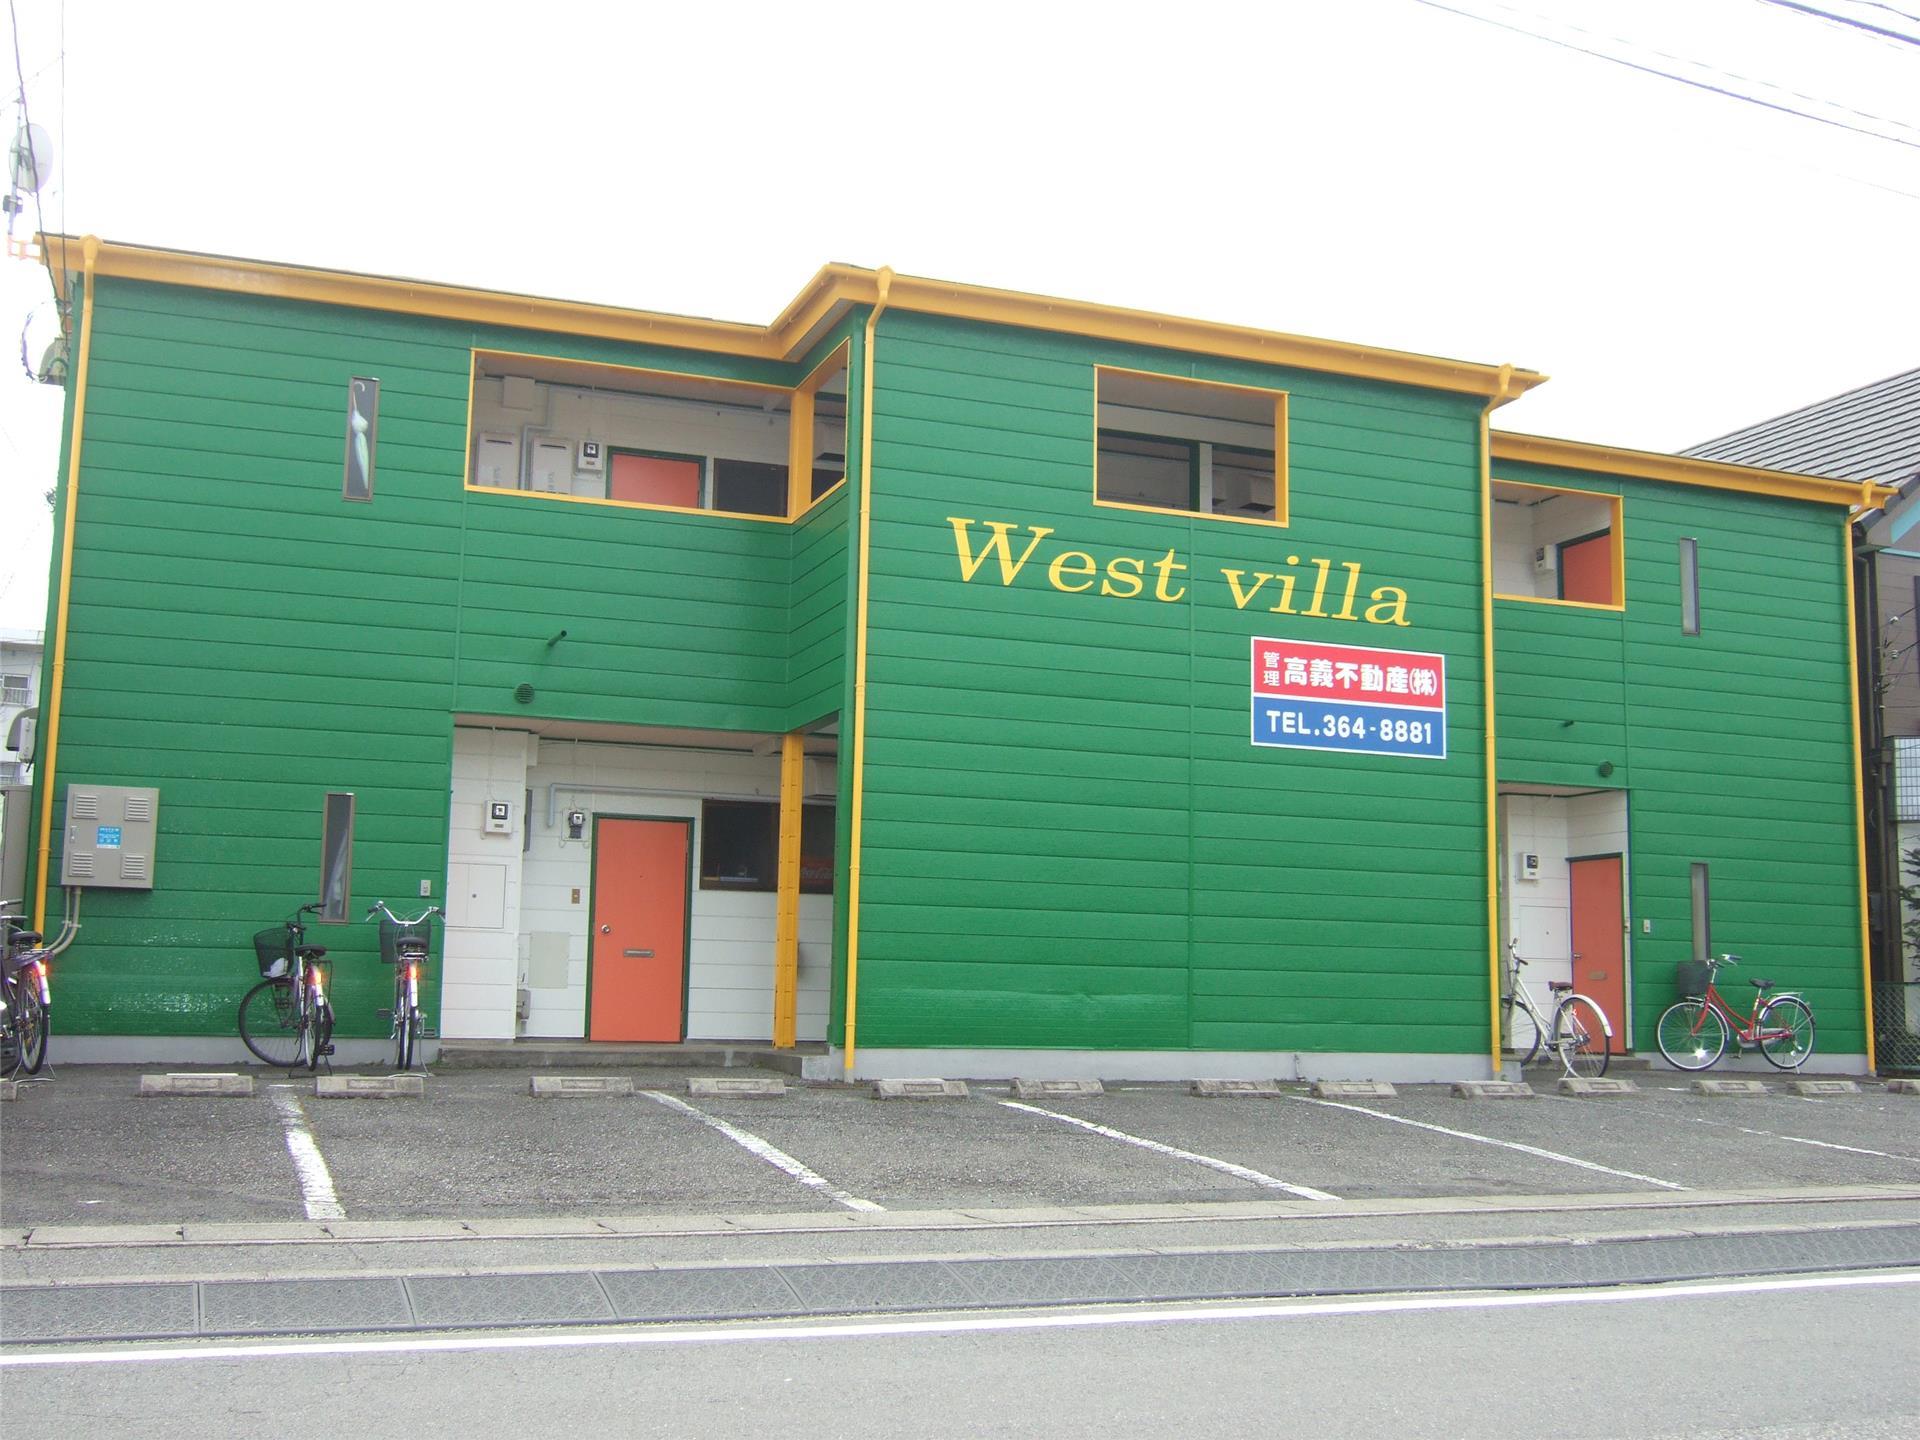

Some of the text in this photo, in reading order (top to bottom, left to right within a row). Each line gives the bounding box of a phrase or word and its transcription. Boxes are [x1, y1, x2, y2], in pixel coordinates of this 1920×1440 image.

[946, 516, 1411, 627] West villa
[1263, 651, 1281, 687] 管理
